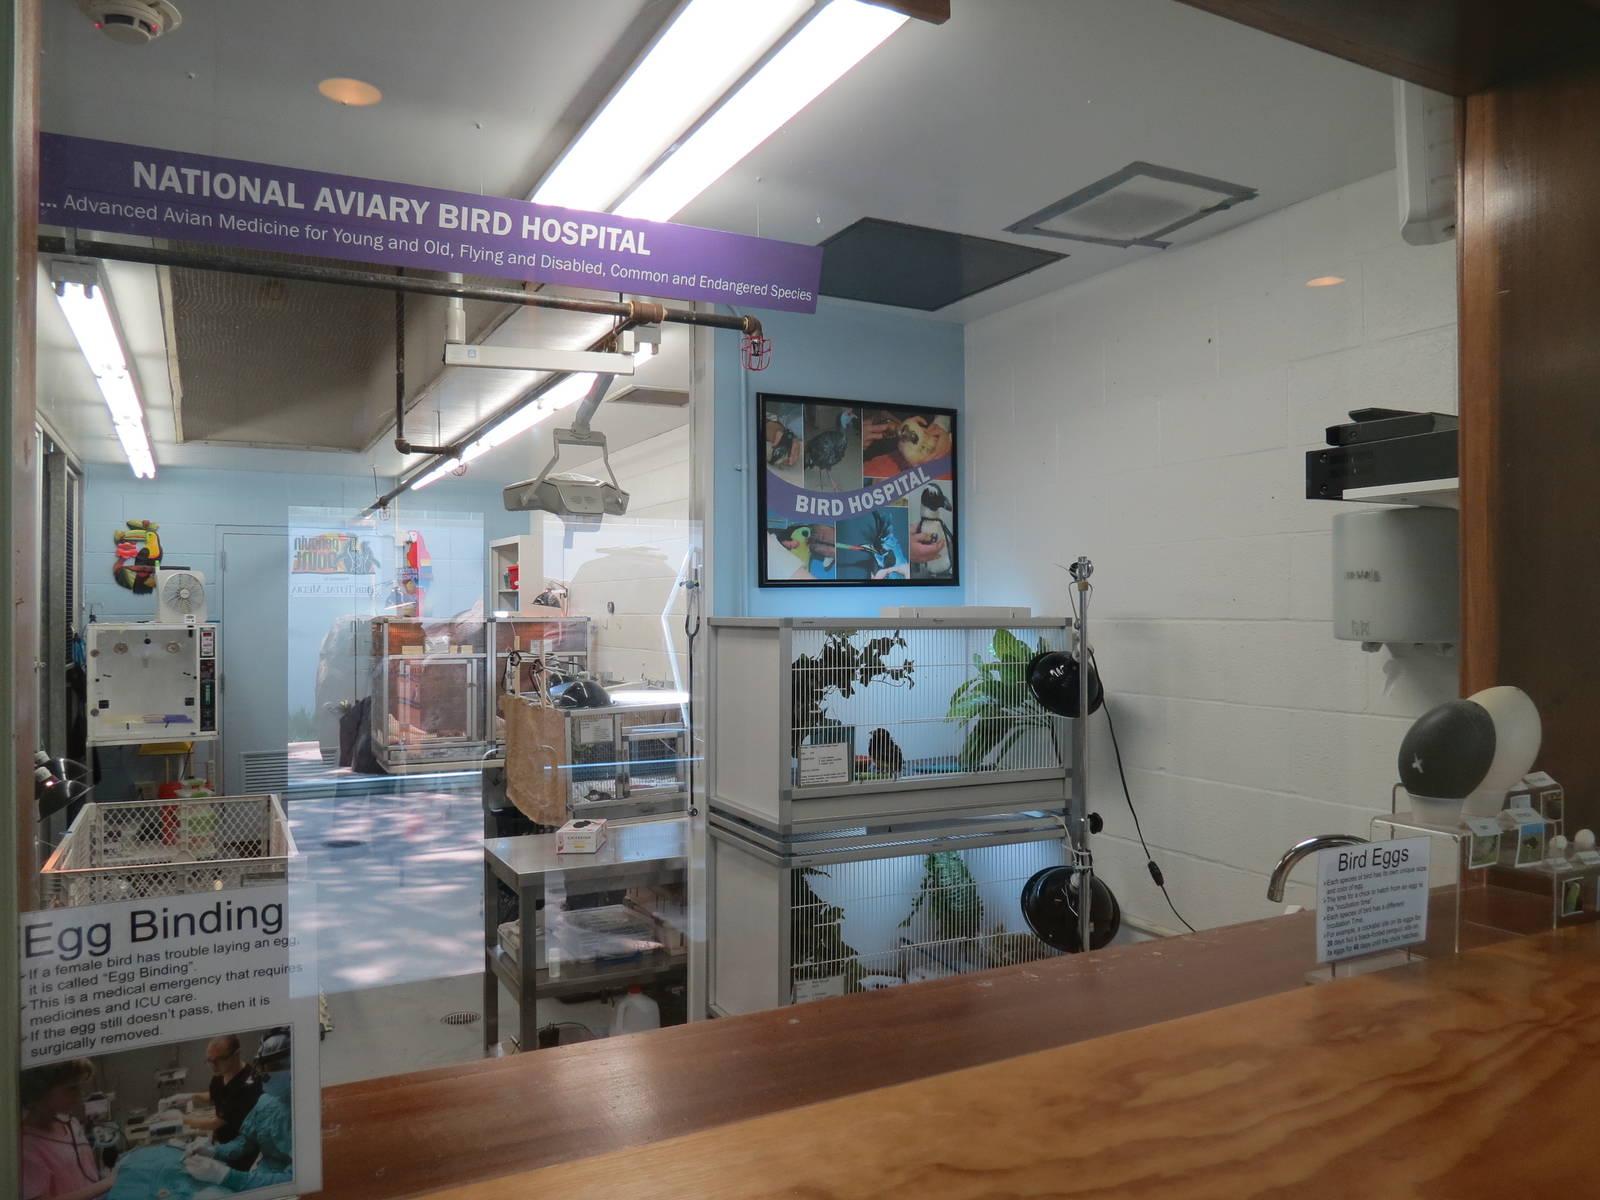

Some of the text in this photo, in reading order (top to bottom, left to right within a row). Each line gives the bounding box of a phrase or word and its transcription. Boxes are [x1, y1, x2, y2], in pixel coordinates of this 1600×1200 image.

[133, 160, 651, 256] NATIONAL AVIARY BIRD HOSPITAL
[64, 194, 158, 221] Advanced
[163, 207, 213, 227] Avian
[219, 215, 300, 238] Medicine
[305, 225, 328, 240] for
[332, 227, 384, 251] Young
[388, 234, 419, 252] and
[424, 239, 454, 260] Old,
[460, 244, 504, 266] Flying
[508, 250, 536, 267] and
[541, 254, 606, 278] Disabled,
[611, 263, 669, 284] Common
[672, 270, 696, 288] and
[700, 275, 768, 297] Endangered
[771, 284, 812, 302] Species
[795, 466, 931, 516] BIRD HOSPITAL
[1338, 847, 1409, 872] Bird Eggs
[25, 900, 283, 961] Egg Binding
[29, 968, 39, 980] If
[42, 968, 51, 978] a
[55, 960, 103, 976] female
[107, 954, 132, 968] bird
[137, 952, 160, 965] has
[165, 945, 209, 960] trouble
[213, 941, 250, 955] laying
[254, 937, 269, 948] an
[29, 985, 37, 996] it
[42, 982, 53, 993] is
[57, 975, 98, 991] called
[30, 963, 303, 1010] This is a medical emergency that requires
[30, 992, 197, 1026] medicines and ICU care.
[30, 995, 270, 1042] If the egg still doesn't pass, then it is
[31, 1025, 163, 1058] surgically removed.
